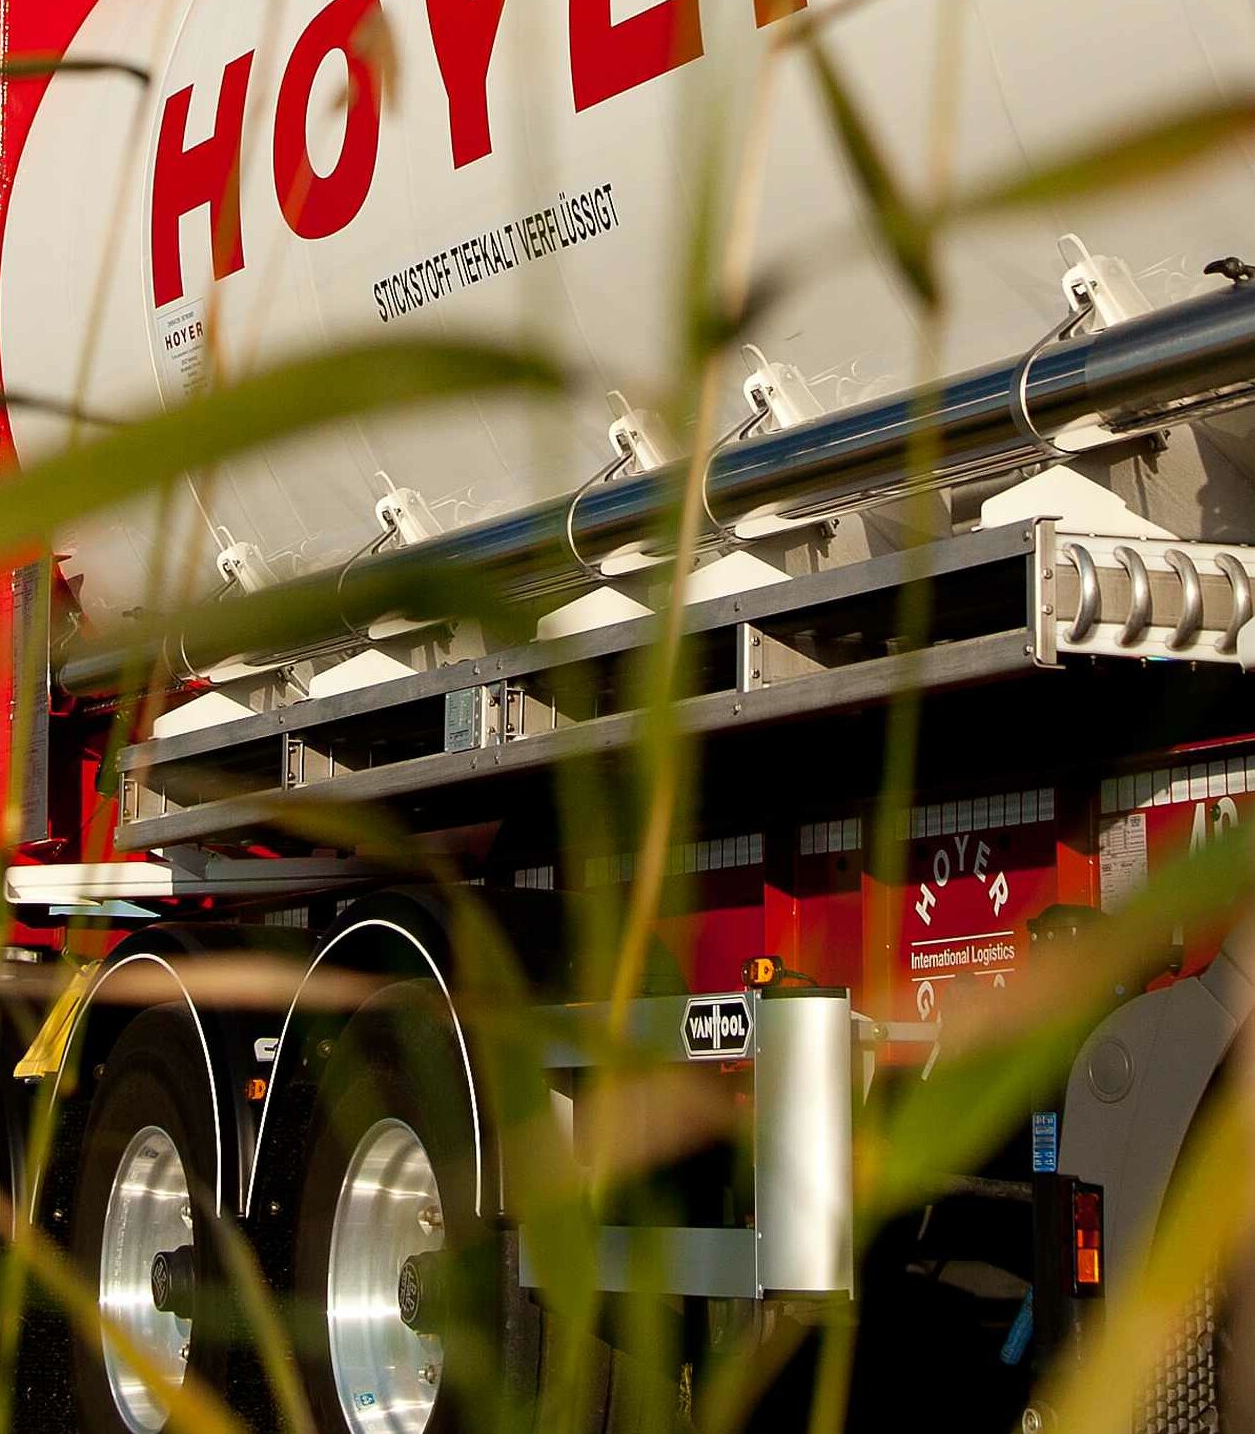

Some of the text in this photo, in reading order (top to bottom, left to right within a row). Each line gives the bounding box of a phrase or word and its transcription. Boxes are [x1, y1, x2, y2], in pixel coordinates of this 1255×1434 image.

[373, 183, 619, 323] STICKSTOFF TIEFKALT VERFLÜSSIGT
[165, 321, 204, 350] HOYER
[915, 835, 1009, 926] HOYER
[911, 942, 1015, 970] International Logistics
